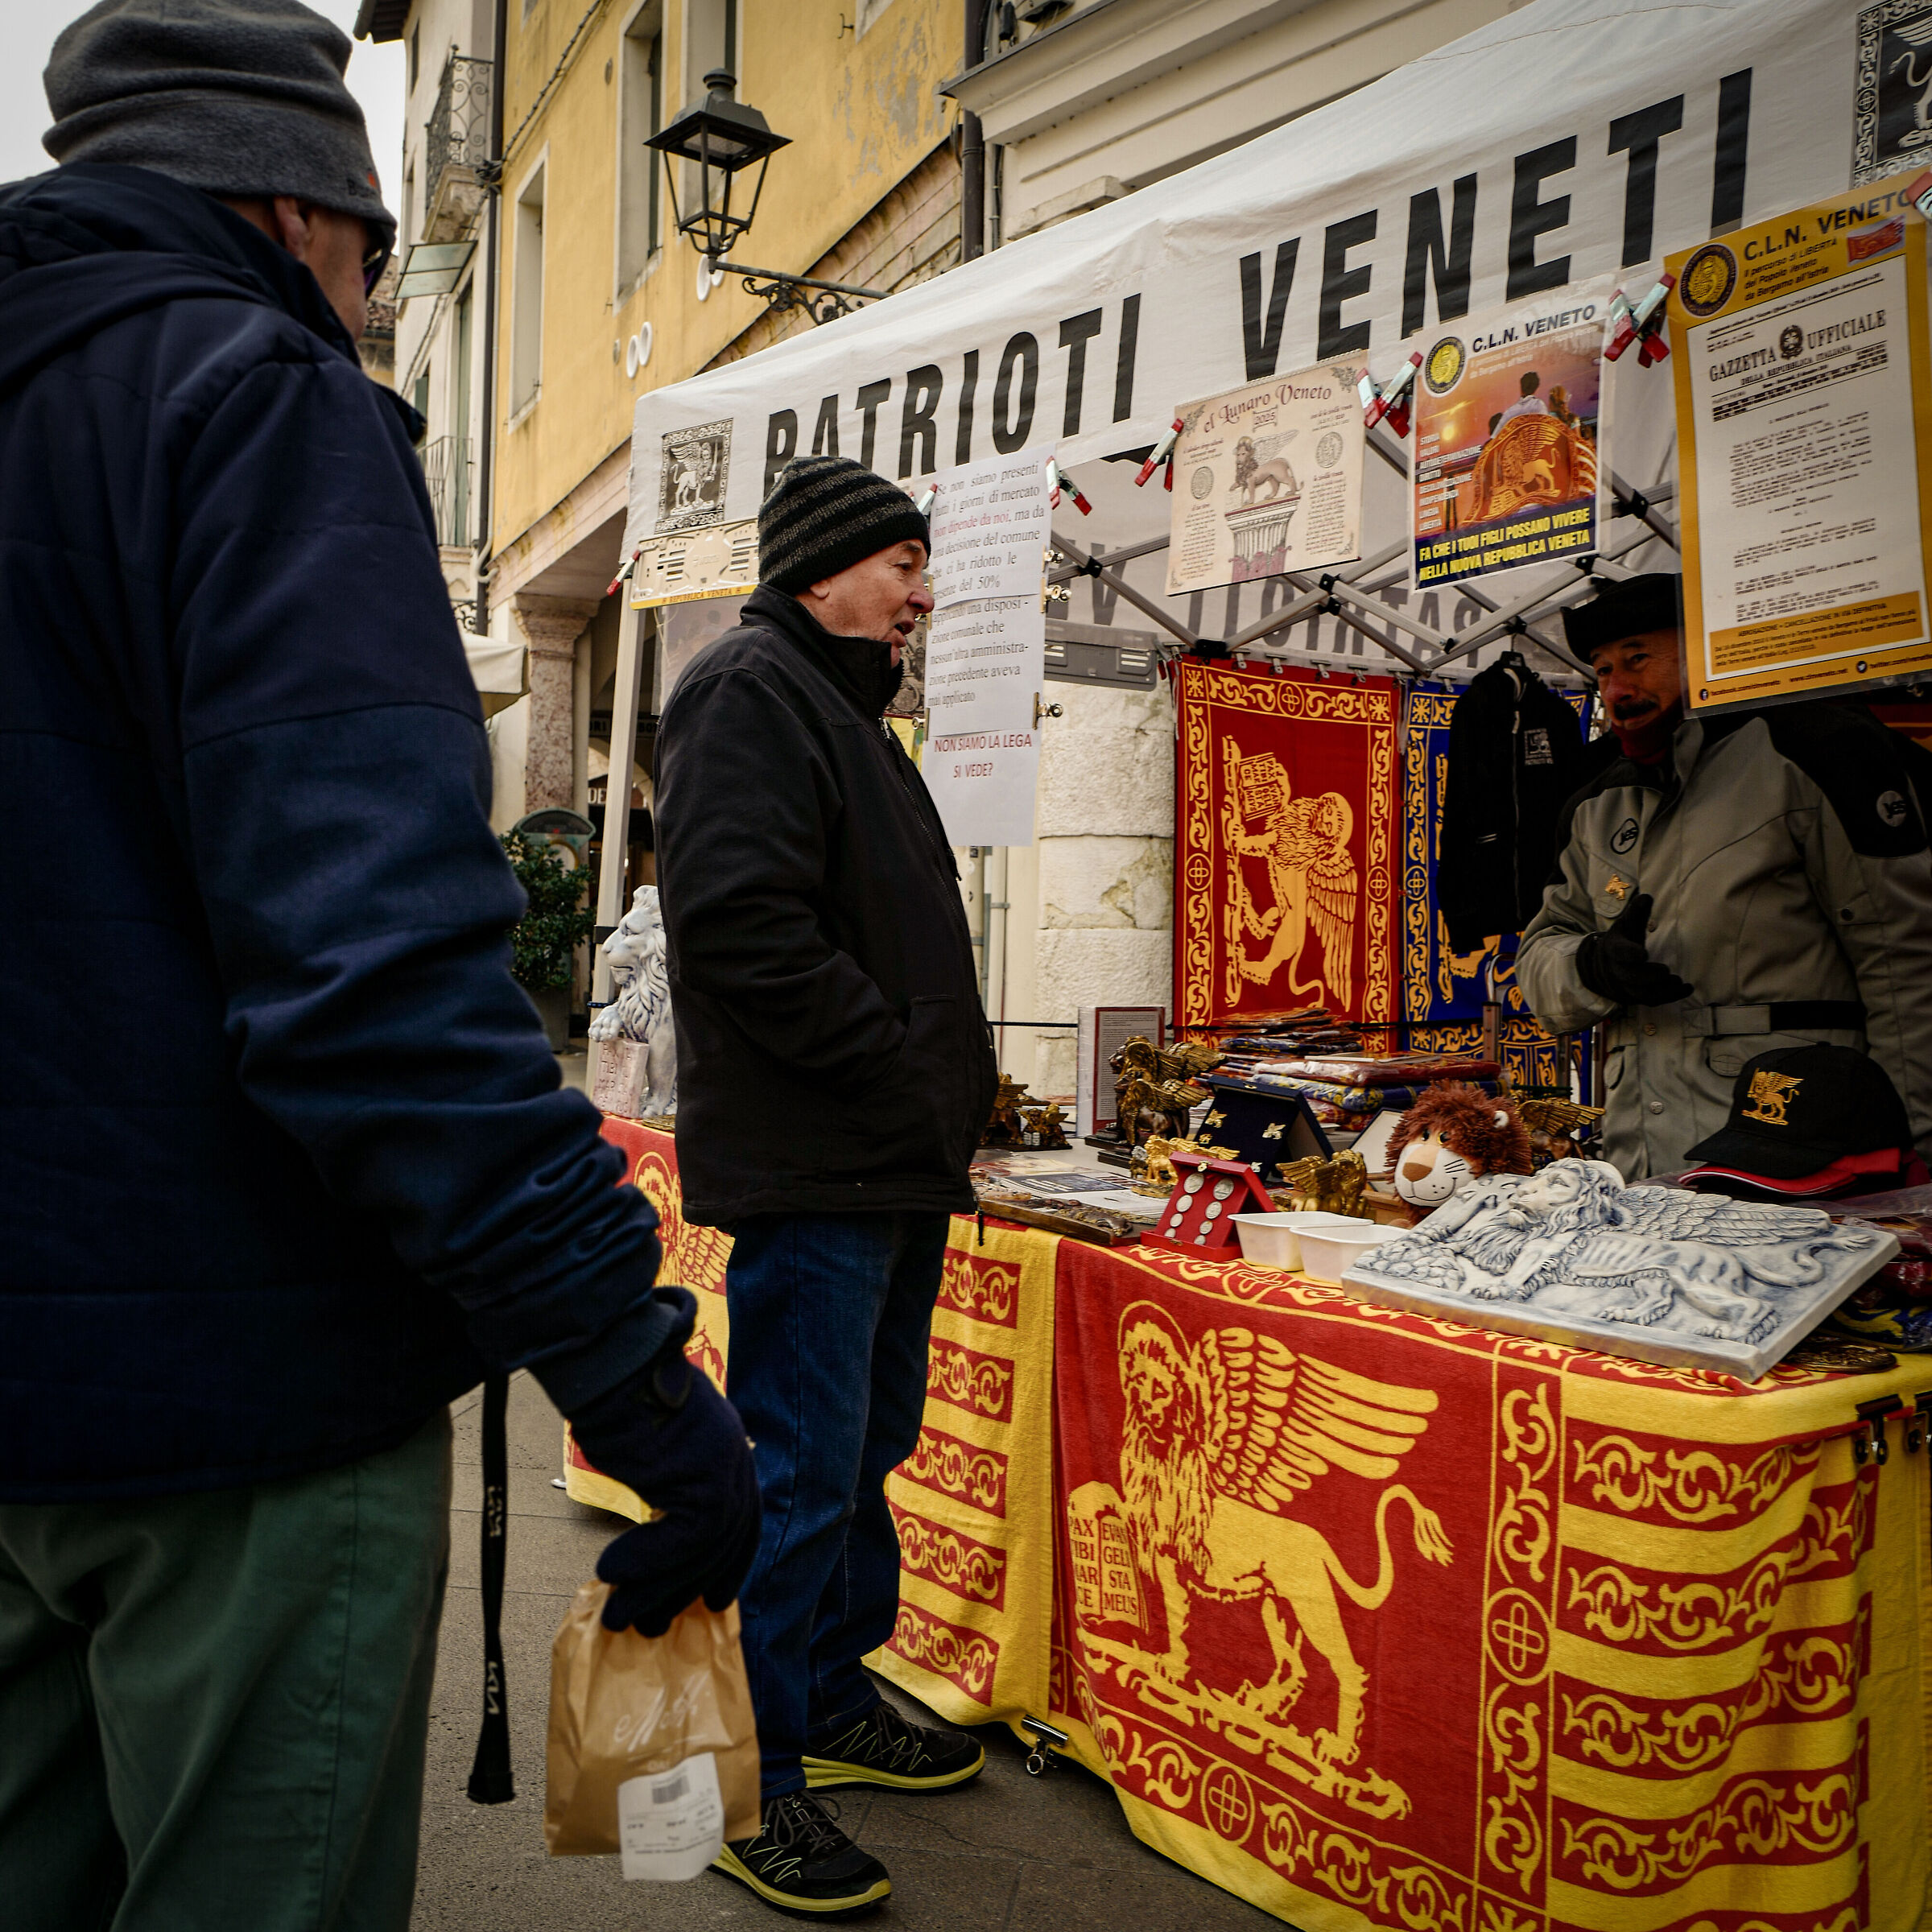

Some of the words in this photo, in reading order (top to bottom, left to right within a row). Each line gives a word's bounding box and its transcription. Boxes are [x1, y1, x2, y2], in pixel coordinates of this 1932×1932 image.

[1744, 225, 1807, 261] C.L.N.
[1817, 189, 1912, 234] VENETO
[763, 292, 1141, 500] PATRIOTI
[1239, 67, 1753, 382] VENETI
[1757, 279, 1794, 296] Bergamo
[1472, 327, 1518, 353] C.L.N.
[1525, 304, 1596, 337] VENETO
[1709, 346, 1777, 382] GAZZETTA
[1807, 309, 1887, 349] UFFICIALE
[1740, 373, 1764, 386] DELLA
[1767, 357, 1813, 378] REPUBBLICA
[1815, 344, 1852, 361] ITALIANA
[1203, 413, 1216, 433] el
[1275, 384, 1332, 406] Veneto
[1253, 411, 1276, 426] 2025
[936, 484, 947, 497] Se
[950, 481, 965, 492] non
[971, 472, 997, 486] siamo
[1001, 460, 1039, 484] presenti
[959, 492, 985, 513] giorni
[989, 489, 999, 504] di
[1001, 485, 1040, 502] mercato
[933, 526, 947, 539] non
[947, 515, 978, 536] dipende
[980, 513, 991, 526] da
[1014, 510, 1030, 521] ma
[1032, 505, 1045, 518] da
[1419, 546, 1432, 562] FA
[1433, 542, 1451, 558] CHE
[1451, 540, 1457, 554] I
[1458, 535, 1480, 553] TUOI
[1480, 528, 1505, 547] FIGLI
[1505, 517, 1551, 541] POSSANO
[1552, 507, 1591, 530] VIVERE
[945, 537, 981, 555] decisione
[983, 531, 998, 547] del
[1000, 530, 1041, 543] comune
[1419, 562, 1449, 581] NELLA
[1449, 554, 1482, 574] NUOVA
[1483, 540, 1547, 567] REPUBBLICA
[1548, 529, 1591, 551] VENETA
[969, 555, 1002, 569] ridotto
[1007, 551, 1018, 565] le
[959, 577, 973, 592] del
[976, 574, 1001, 589] 50%
[967, 603, 982, 615] una
[931, 630, 950, 644] zione
[951, 622, 985, 640] comunale
[986, 620, 1005, 634] che
[928, 672, 946, 686] zione
[947, 667, 989, 686] precedente
[990, 666, 1022, 678] aveva
[942, 691, 976, 708] applicato
[934, 737, 956, 753] NON
[958, 736, 987, 751] SIAMO
[989, 735, 1001, 749] LA
[1003, 733, 1033, 748] LEGA
[953, 765, 962, 778] SI
[964, 762, 994, 778] VEDE?
[1108, 1570, 1132, 1591] STA
